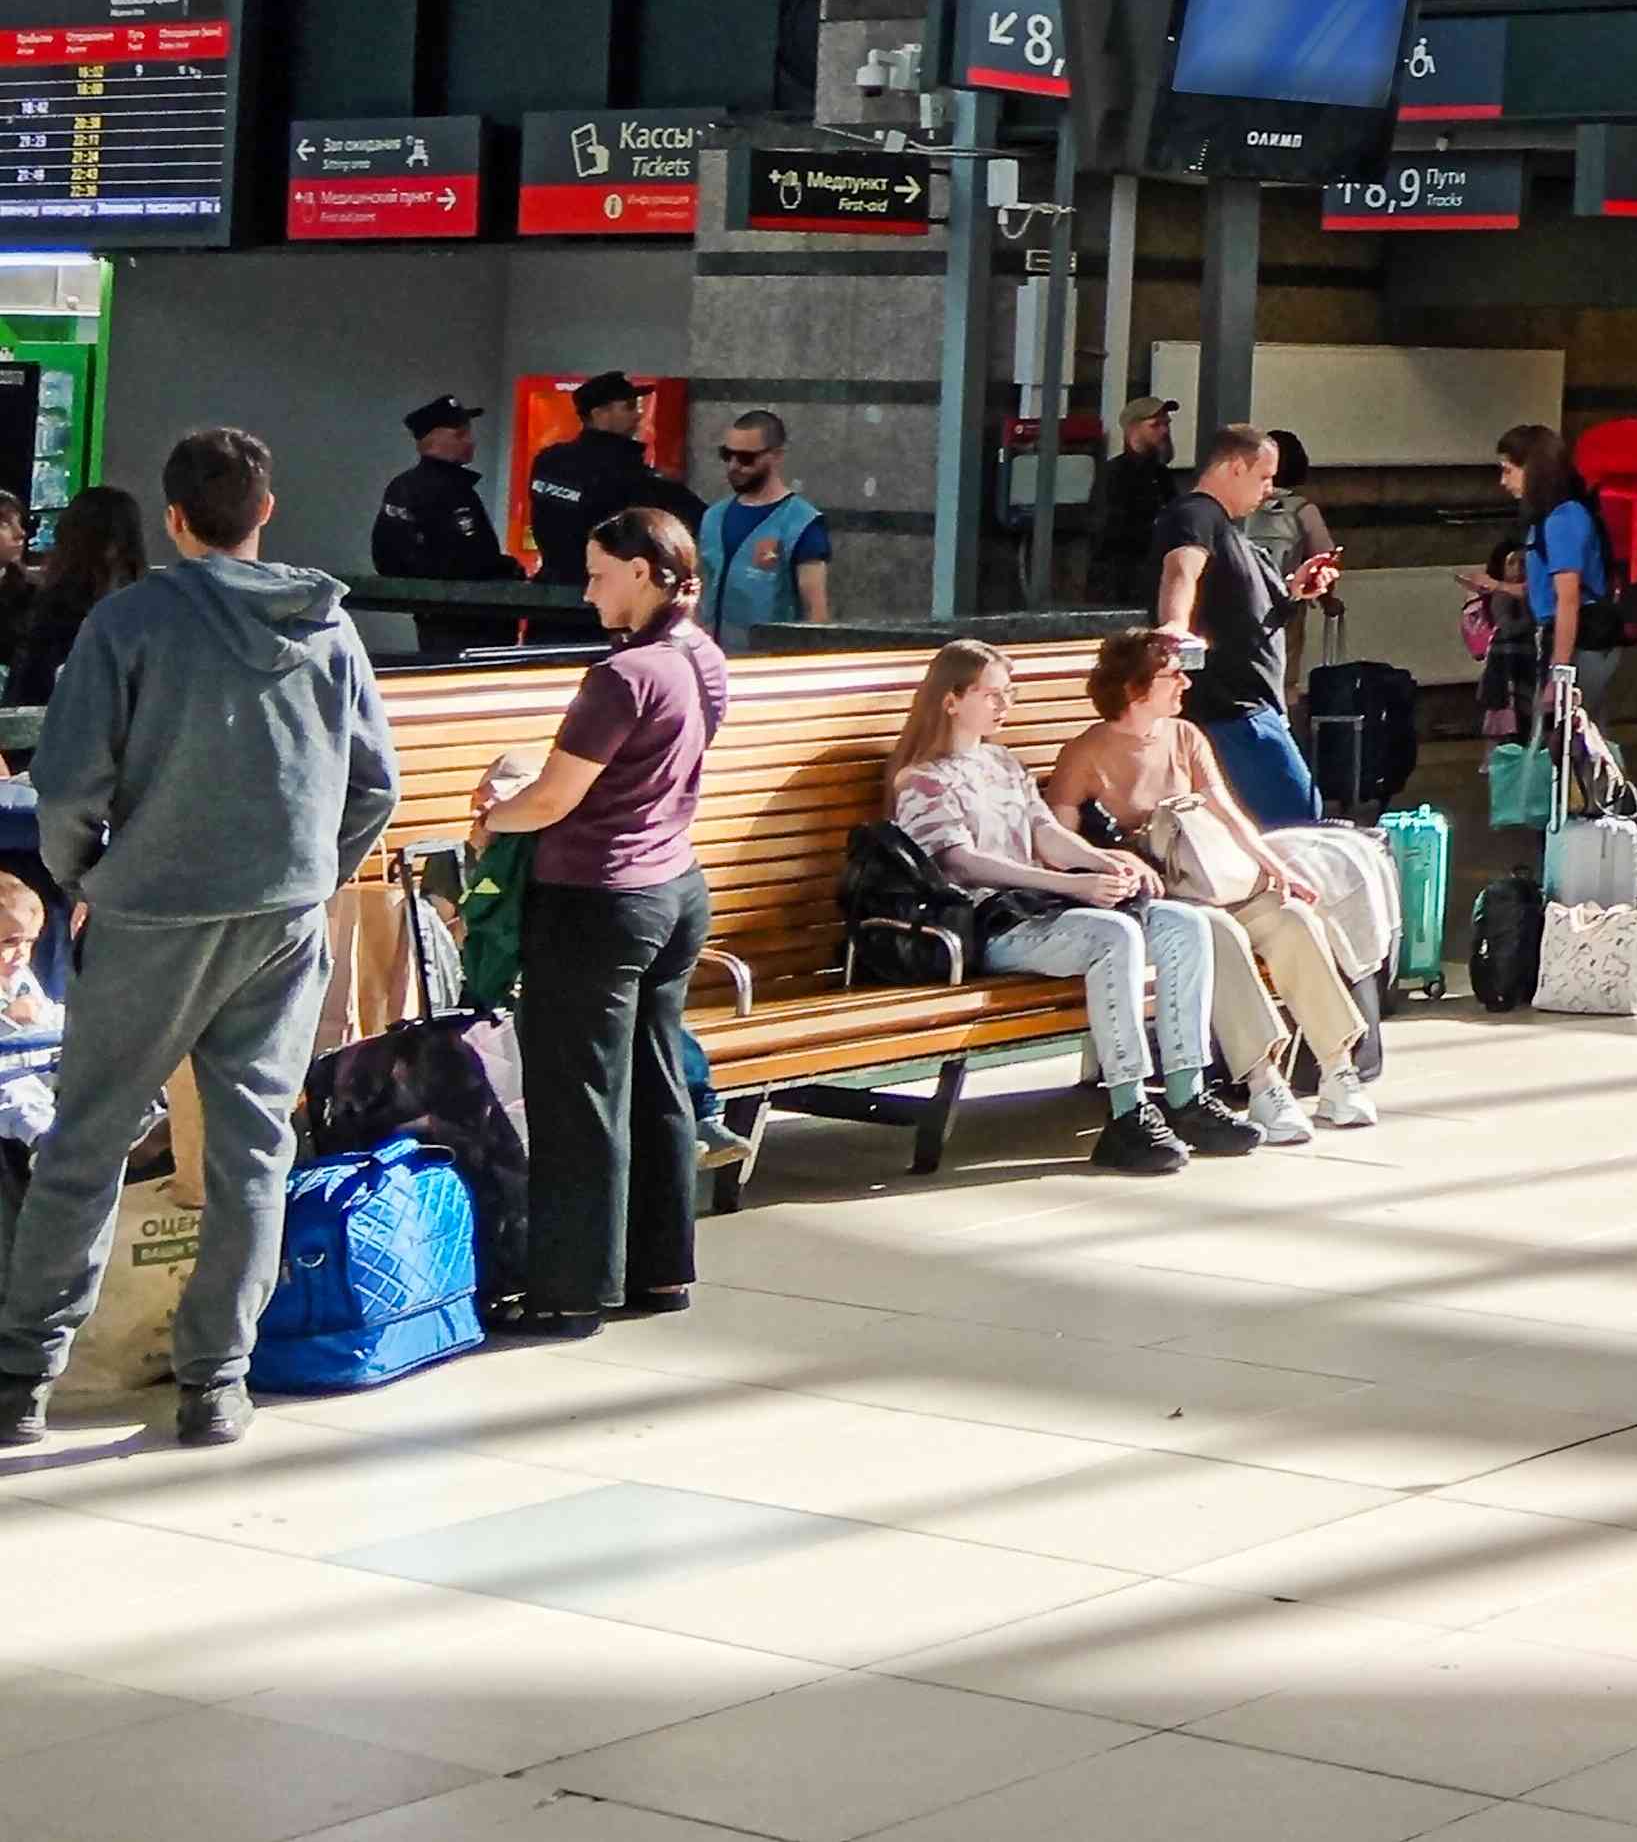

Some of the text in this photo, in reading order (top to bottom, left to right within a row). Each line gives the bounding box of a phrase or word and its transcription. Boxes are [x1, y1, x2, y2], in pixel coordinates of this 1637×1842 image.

[619, 121, 694, 150] Кассы
[1247, 130, 1303, 149] ОЛИМП
[632, 156, 691, 177] Tickets
[806, 170, 888, 195] Медпункт
[1426, 167, 1467, 190] Пути
[838, 197, 889, 213] First-aid
[1426, 193, 1465, 208] Tracks
